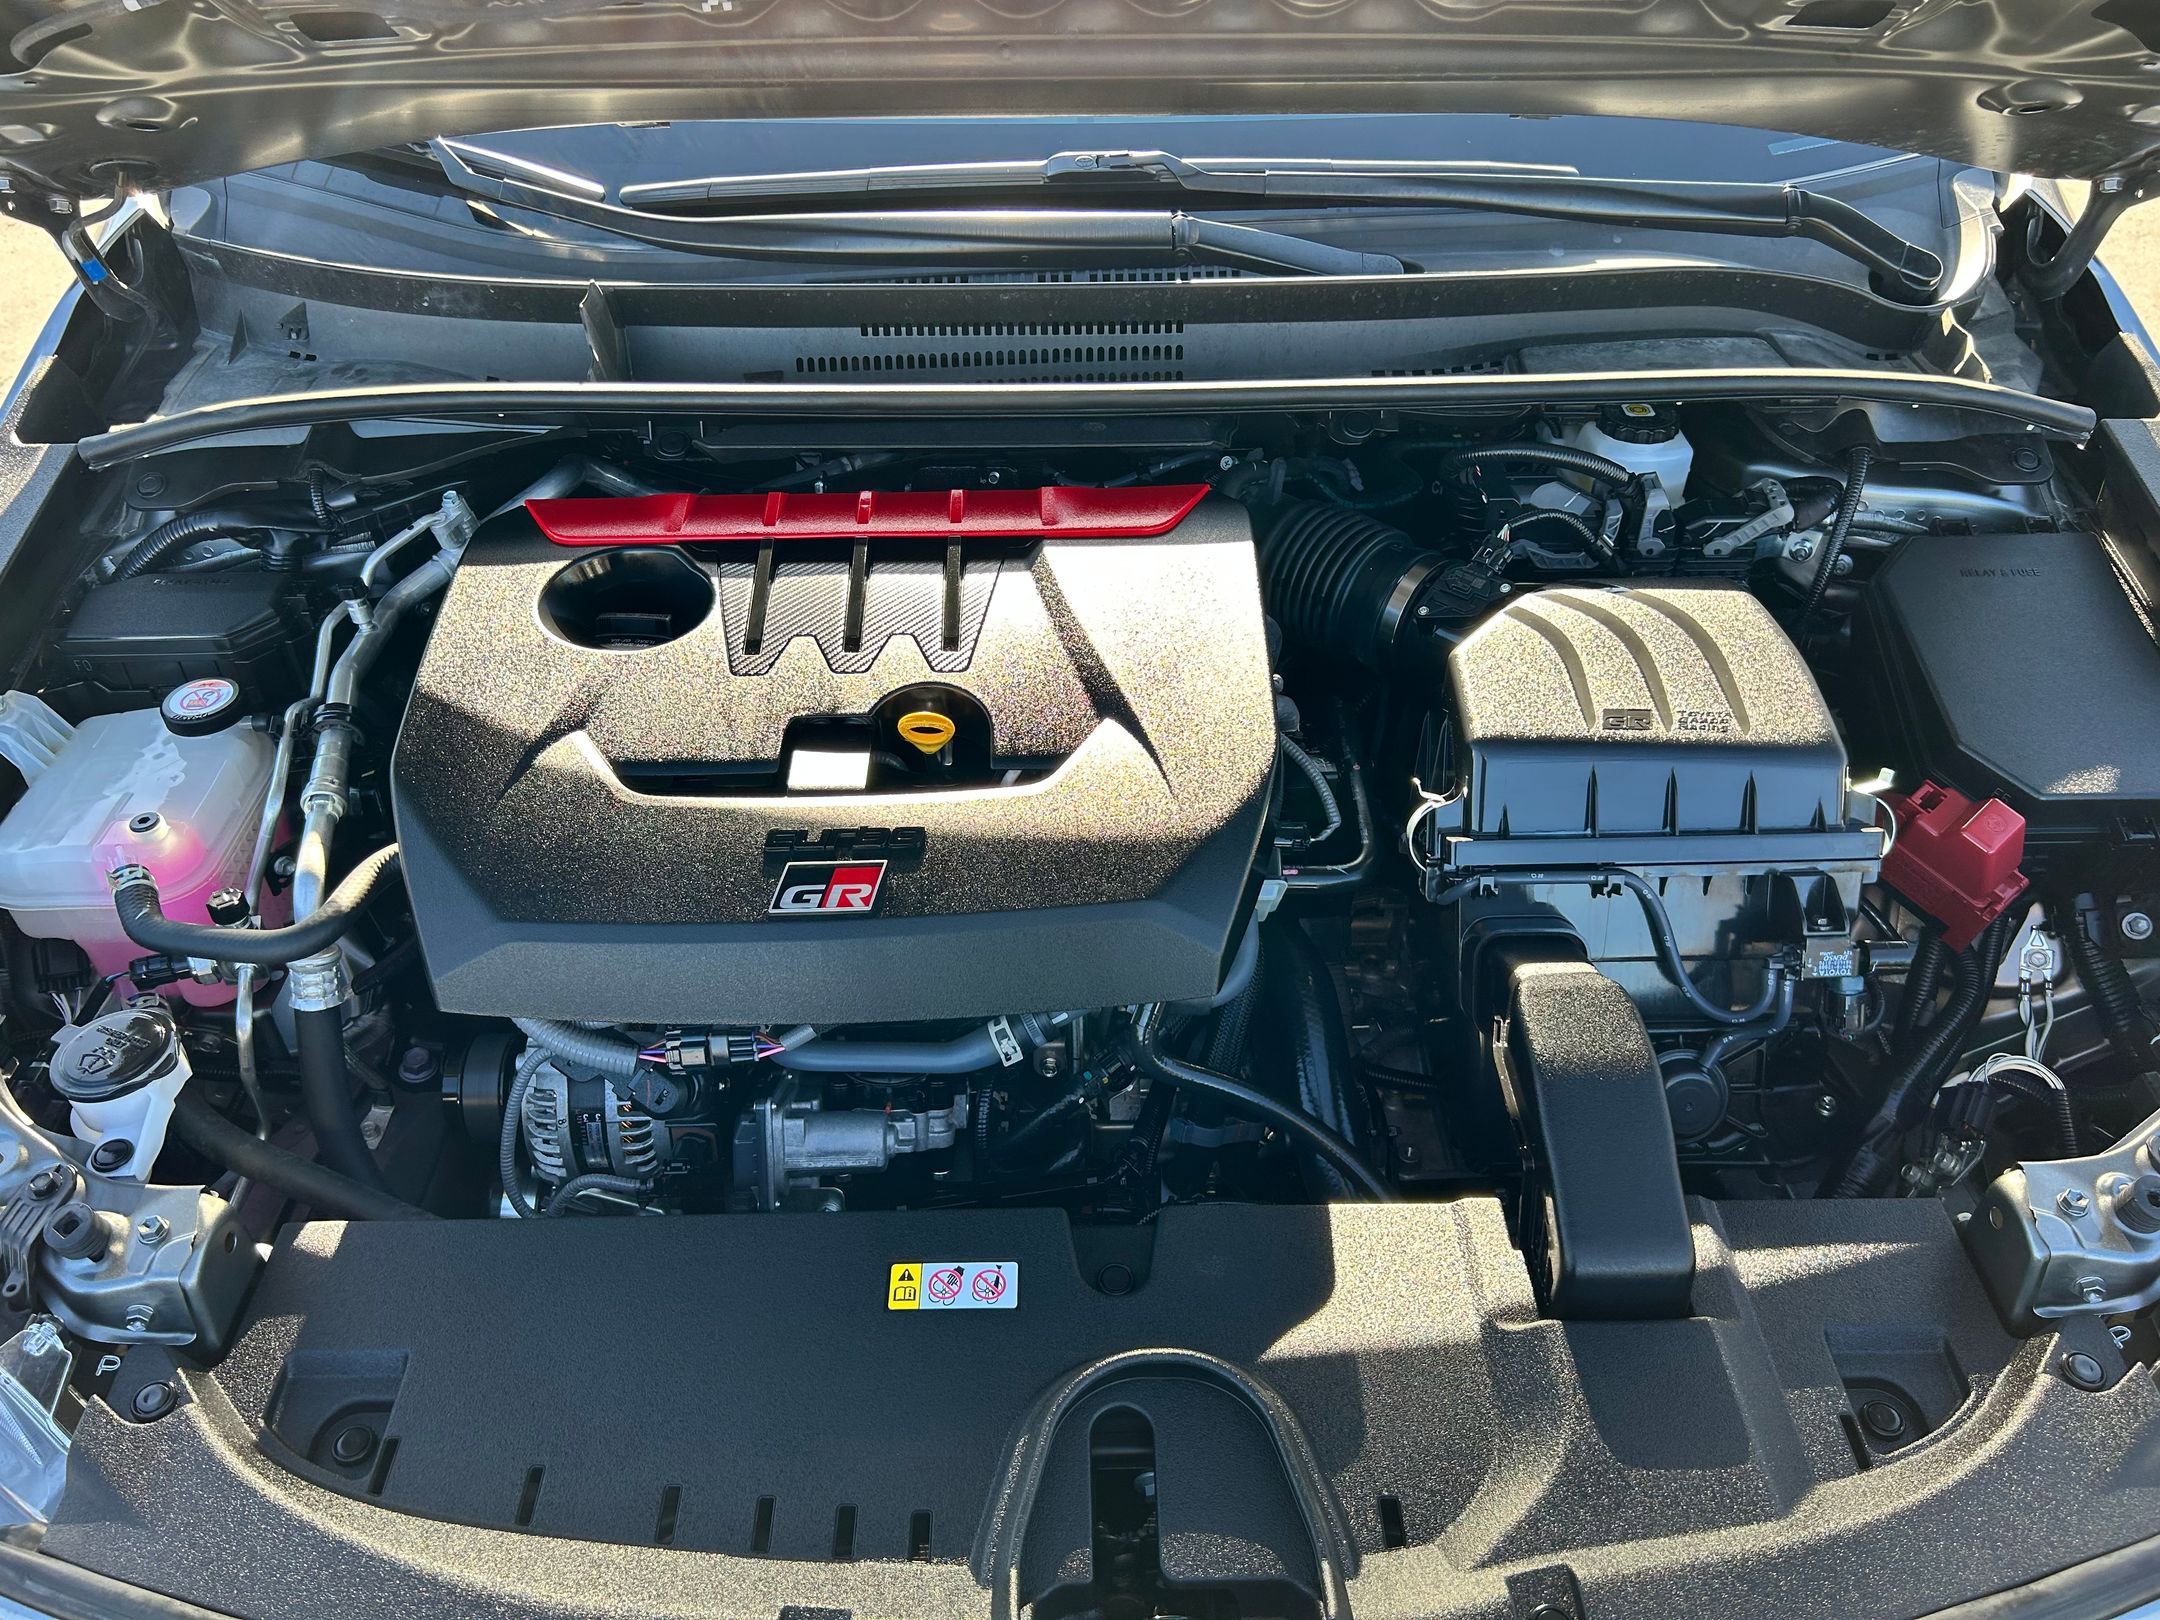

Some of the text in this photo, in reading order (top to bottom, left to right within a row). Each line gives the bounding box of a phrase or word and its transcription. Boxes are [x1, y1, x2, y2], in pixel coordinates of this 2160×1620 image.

[1604, 715, 1651, 730] GR
[779, 883, 873, 909] GR
[1819, 968, 1852, 977] TOYOTA
[2109, 1325, 2131, 1349] P
[95, 1355, 120, 1376] P
